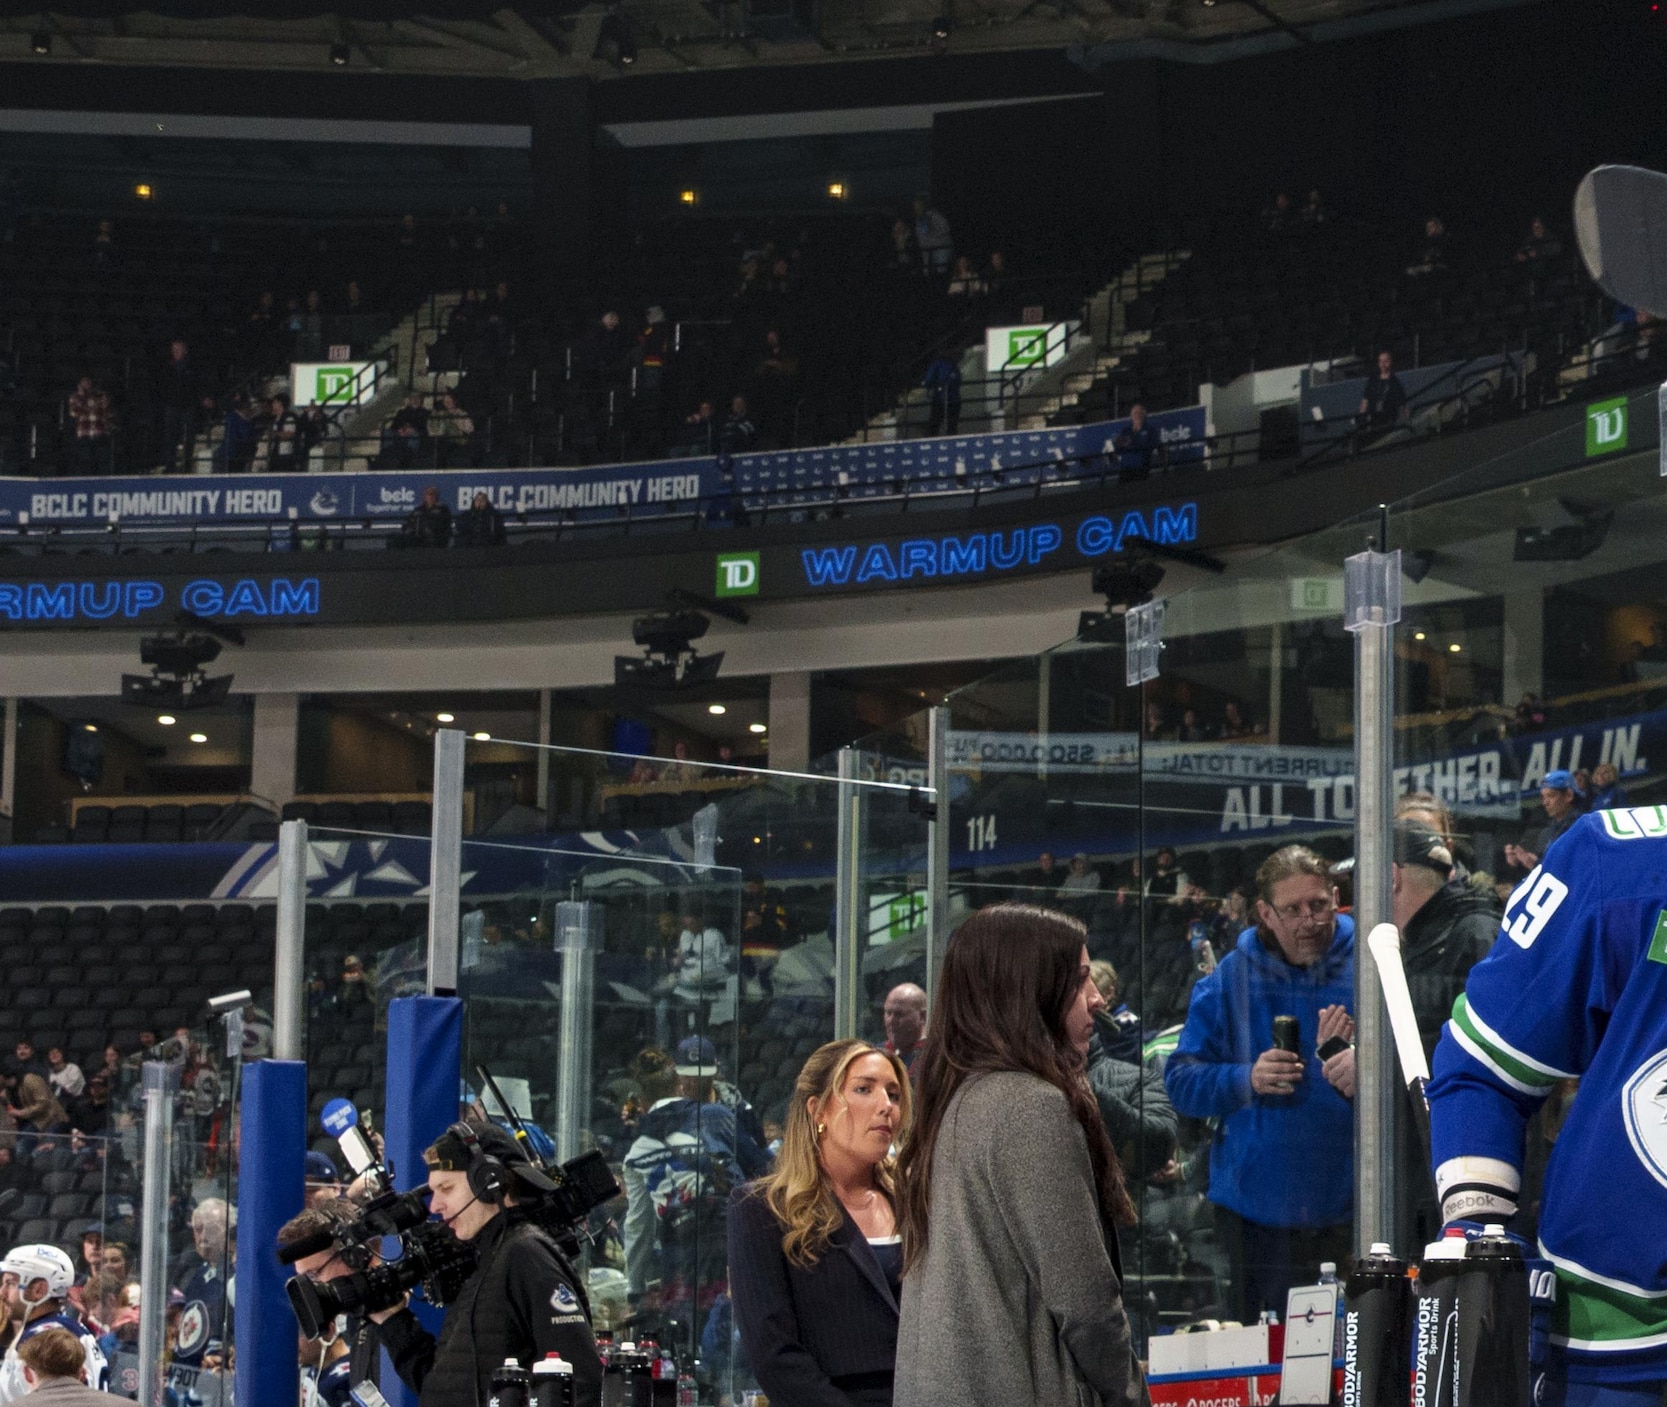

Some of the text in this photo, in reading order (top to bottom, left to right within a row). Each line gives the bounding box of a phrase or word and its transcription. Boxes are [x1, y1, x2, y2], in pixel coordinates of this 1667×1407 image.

[32, 489, 282, 518] BCLC COMMUNITY HERO
[520, 479, 642, 510] COMMUNITY
[648, 475, 699, 502] HERO
[801, 502, 1197, 586] WARMUP CAM
[721, 560, 755, 588] TD
[181, 577, 320, 617] CAM
[1220, 783, 1293, 834] ALL
[1307, 751, 1512, 822] TOETHER.
[1522, 735, 1583, 792] ALL
[967, 814, 998, 852] 114
[1501, 864, 1568, 949] 29
[551, 1315, 585, 1325] PRODUCTION
[1429, 1298, 1439, 1355] Sports Drink
